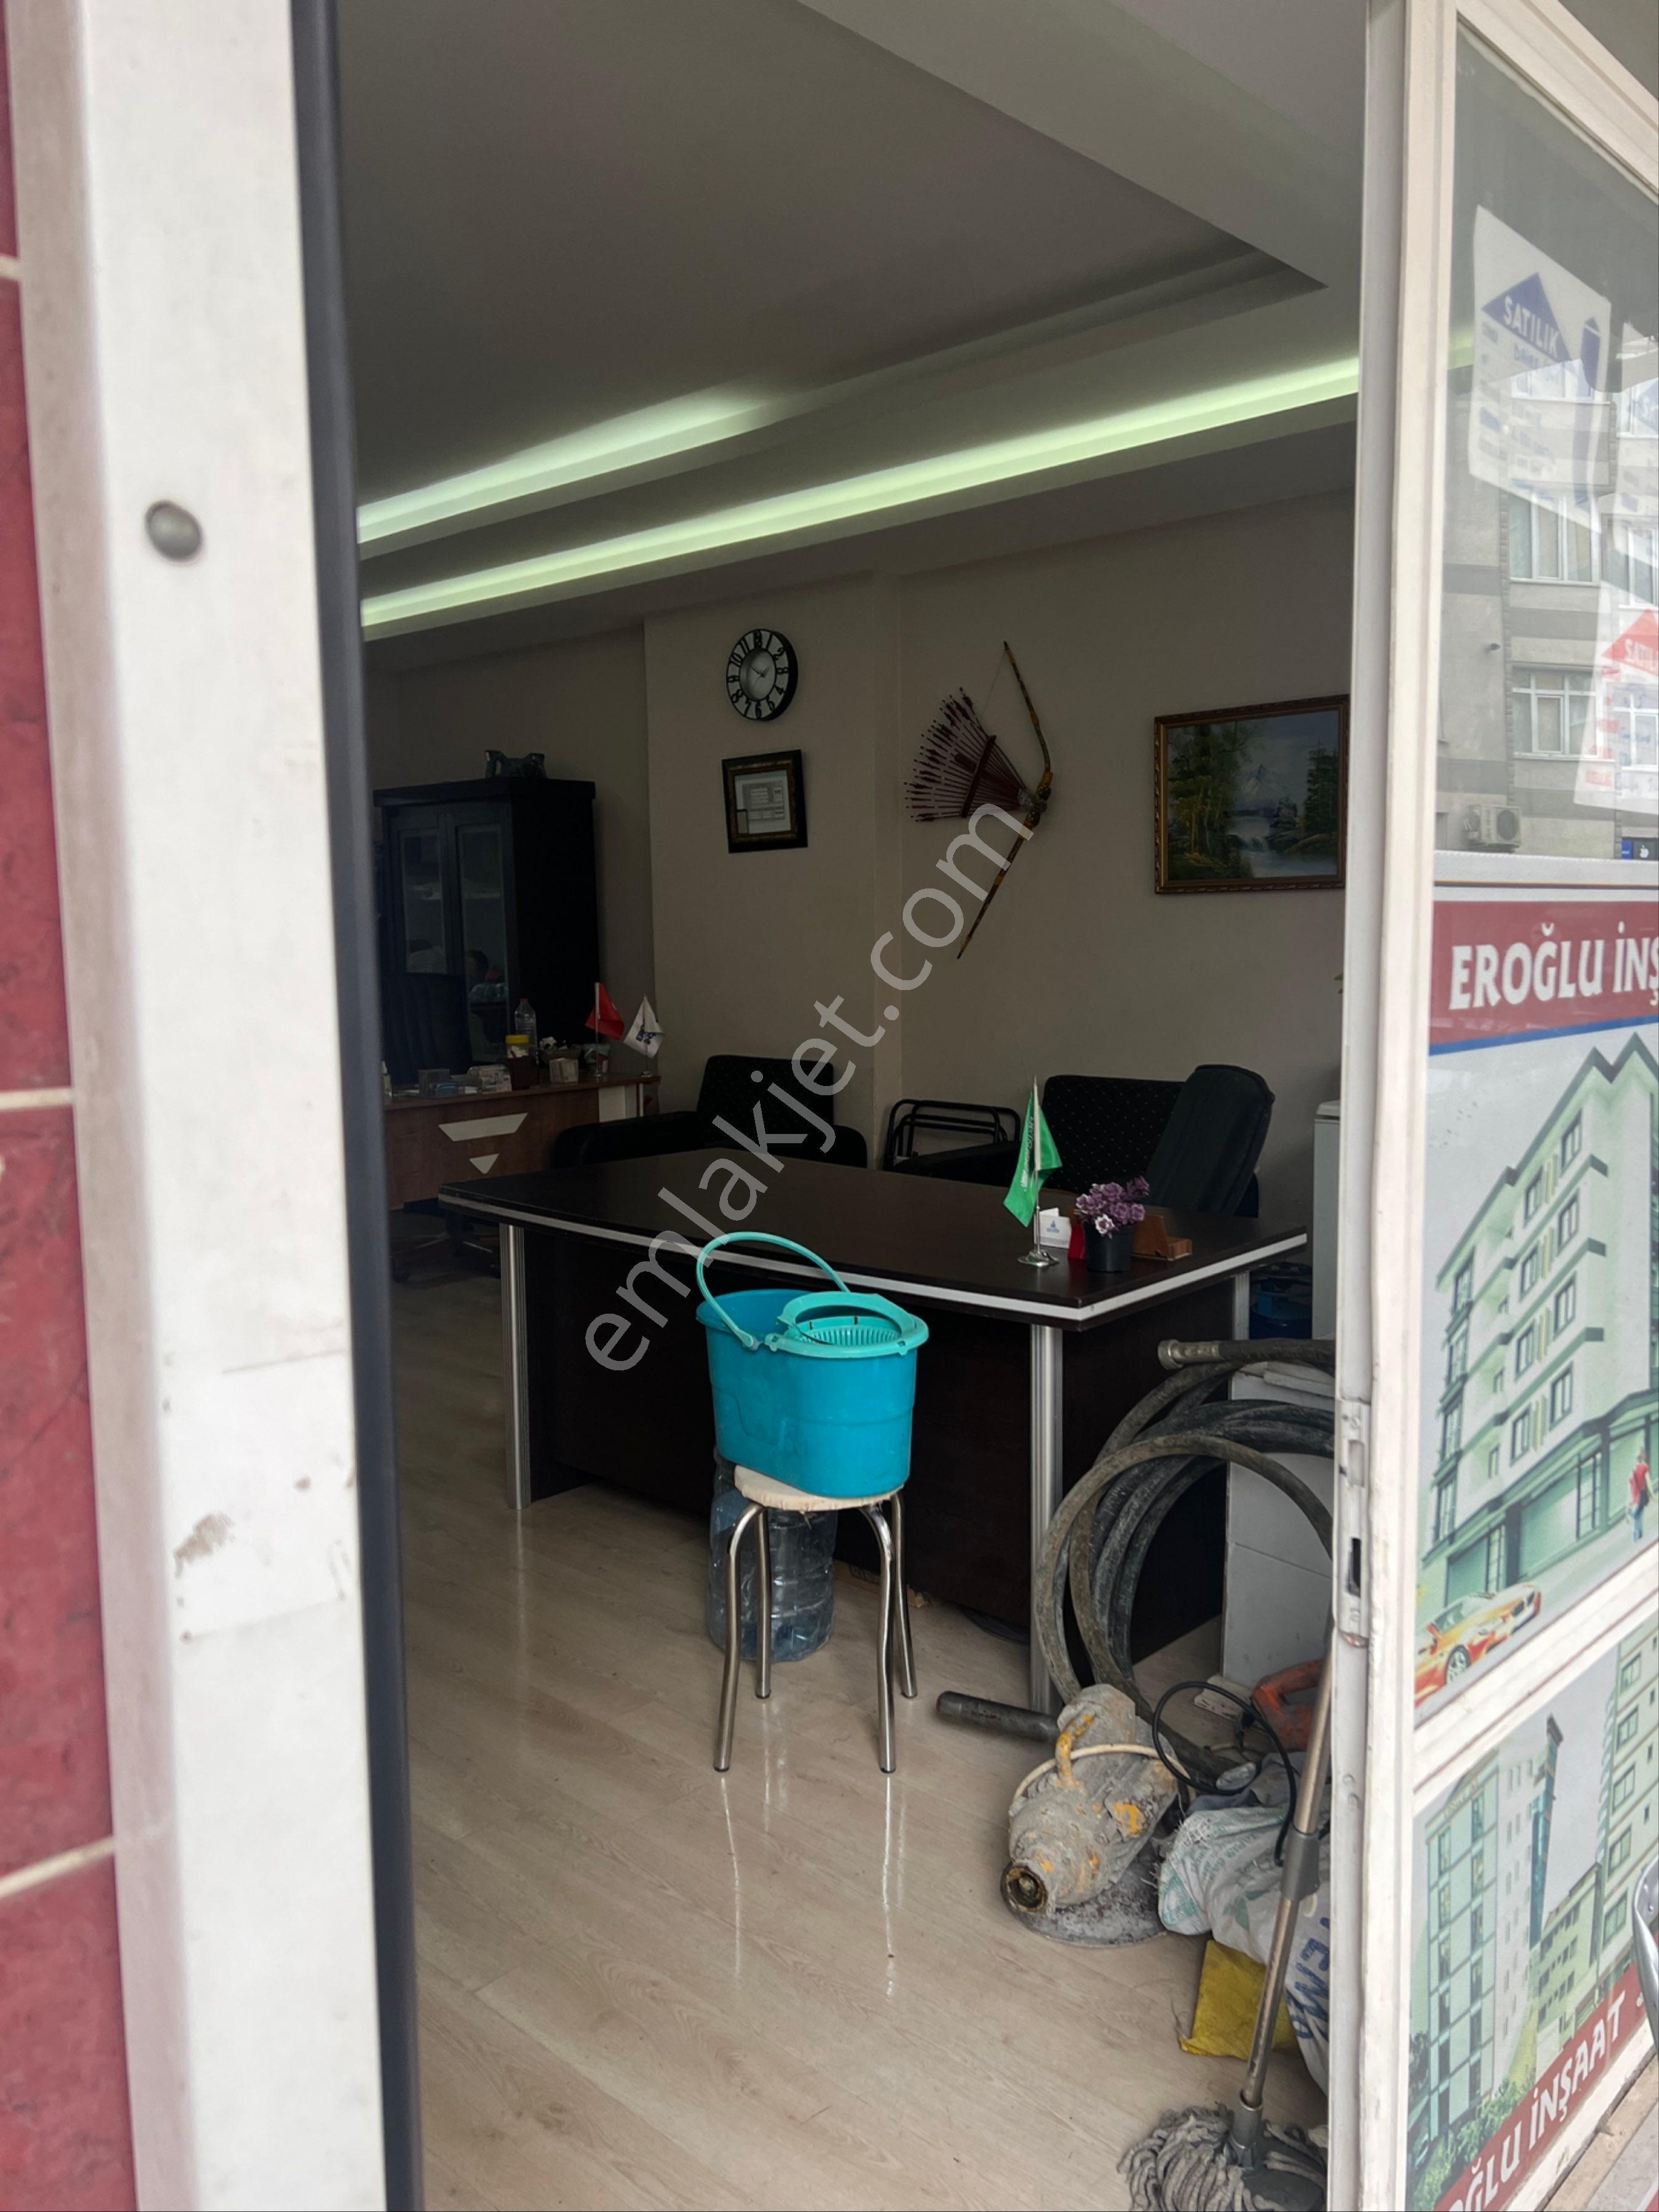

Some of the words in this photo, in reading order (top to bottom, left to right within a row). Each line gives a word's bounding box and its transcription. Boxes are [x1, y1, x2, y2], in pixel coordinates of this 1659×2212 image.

[1503, 295, 1559, 359] SATILIK
[1449, 922, 1605, 1010] EROĞLU
[1448, 2120, 1522, 2212] ĞLU
[1529, 1990, 1626, 2151] İNŞAAT
